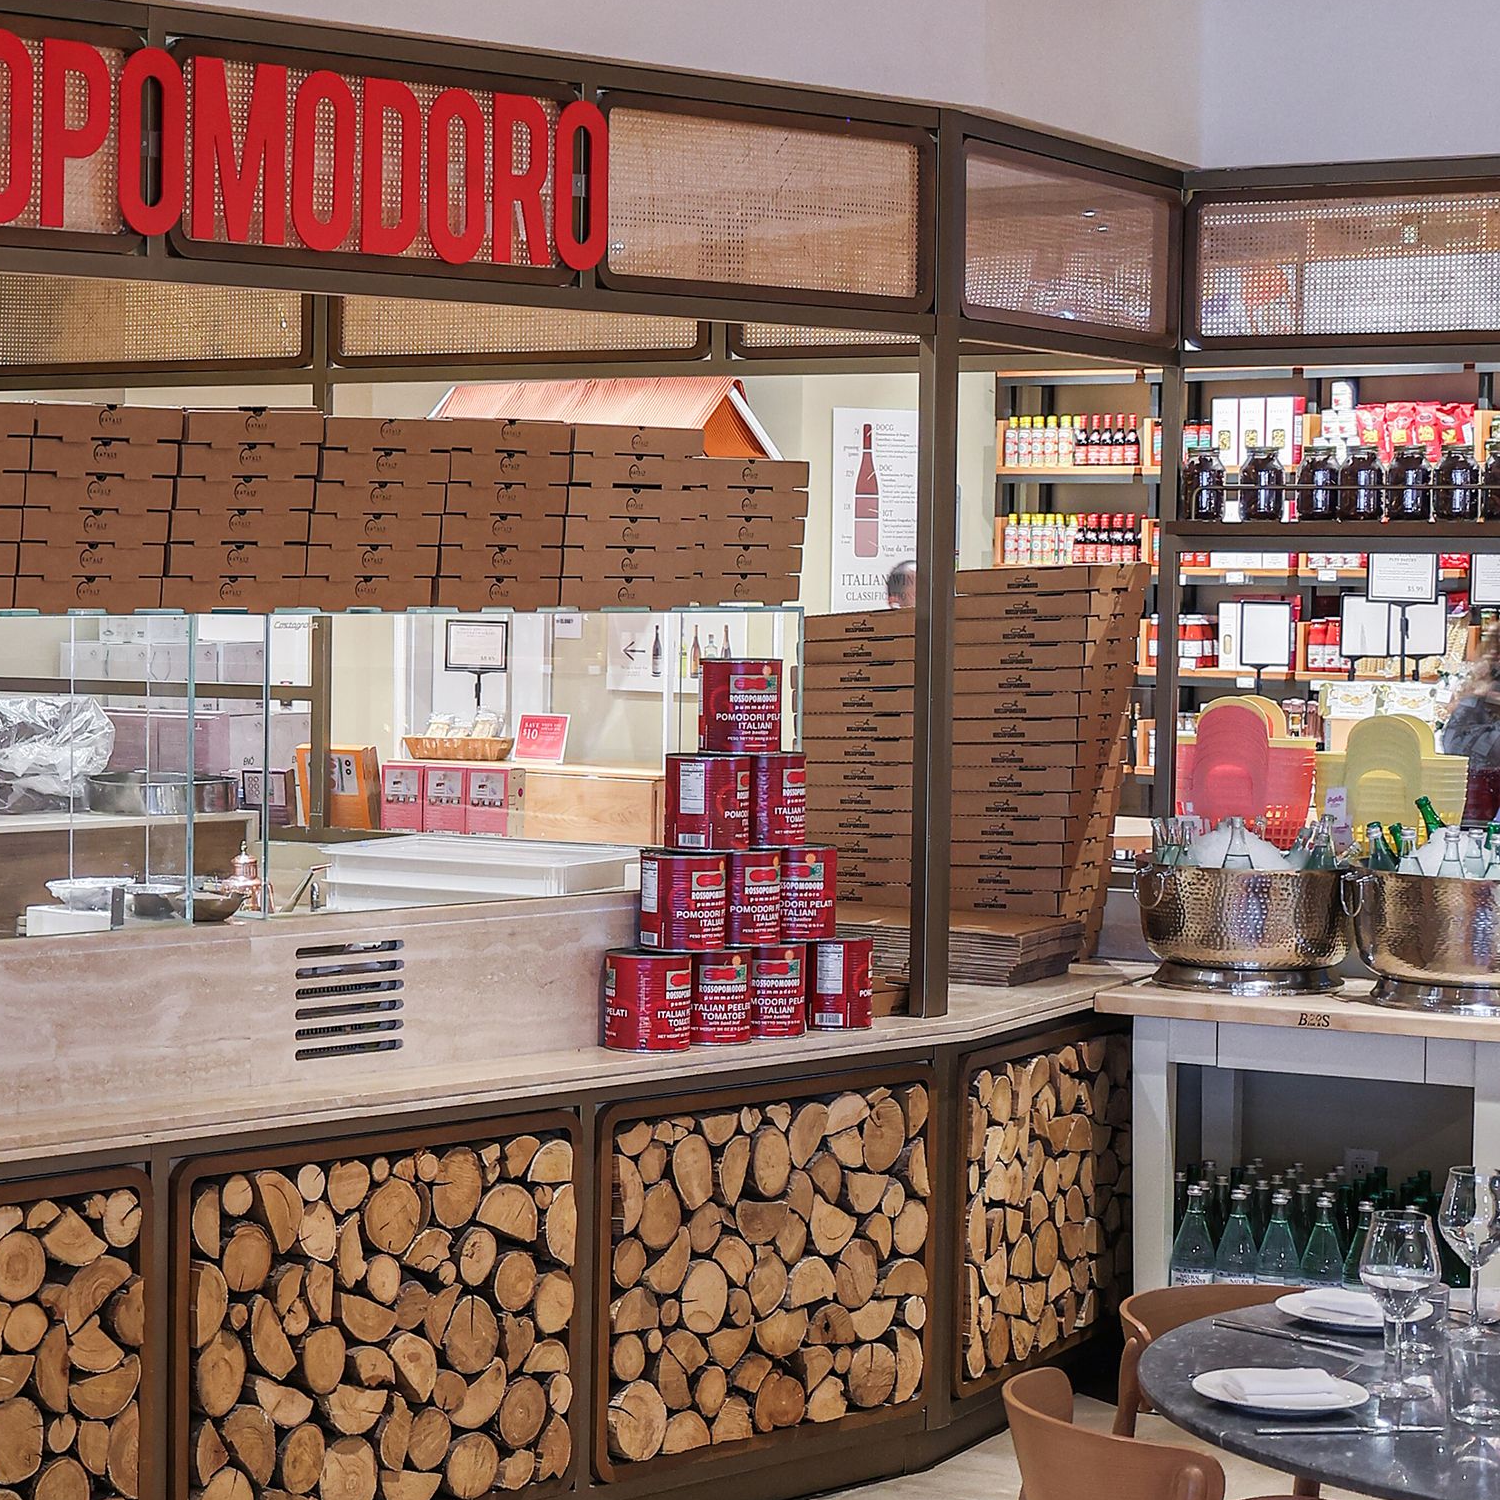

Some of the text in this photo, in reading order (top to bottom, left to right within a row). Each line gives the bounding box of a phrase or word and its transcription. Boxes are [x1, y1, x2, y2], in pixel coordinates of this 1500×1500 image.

[716, 713, 765, 722] POMODORI
[738, 722, 773, 730] ITALIANI
[730, 904, 775, 913] POMODORI
[676, 909, 720, 919] POMODORI
[760, 1006, 795, 1014] ITALIANI
[702, 1011, 746, 1021] TOMATOES
